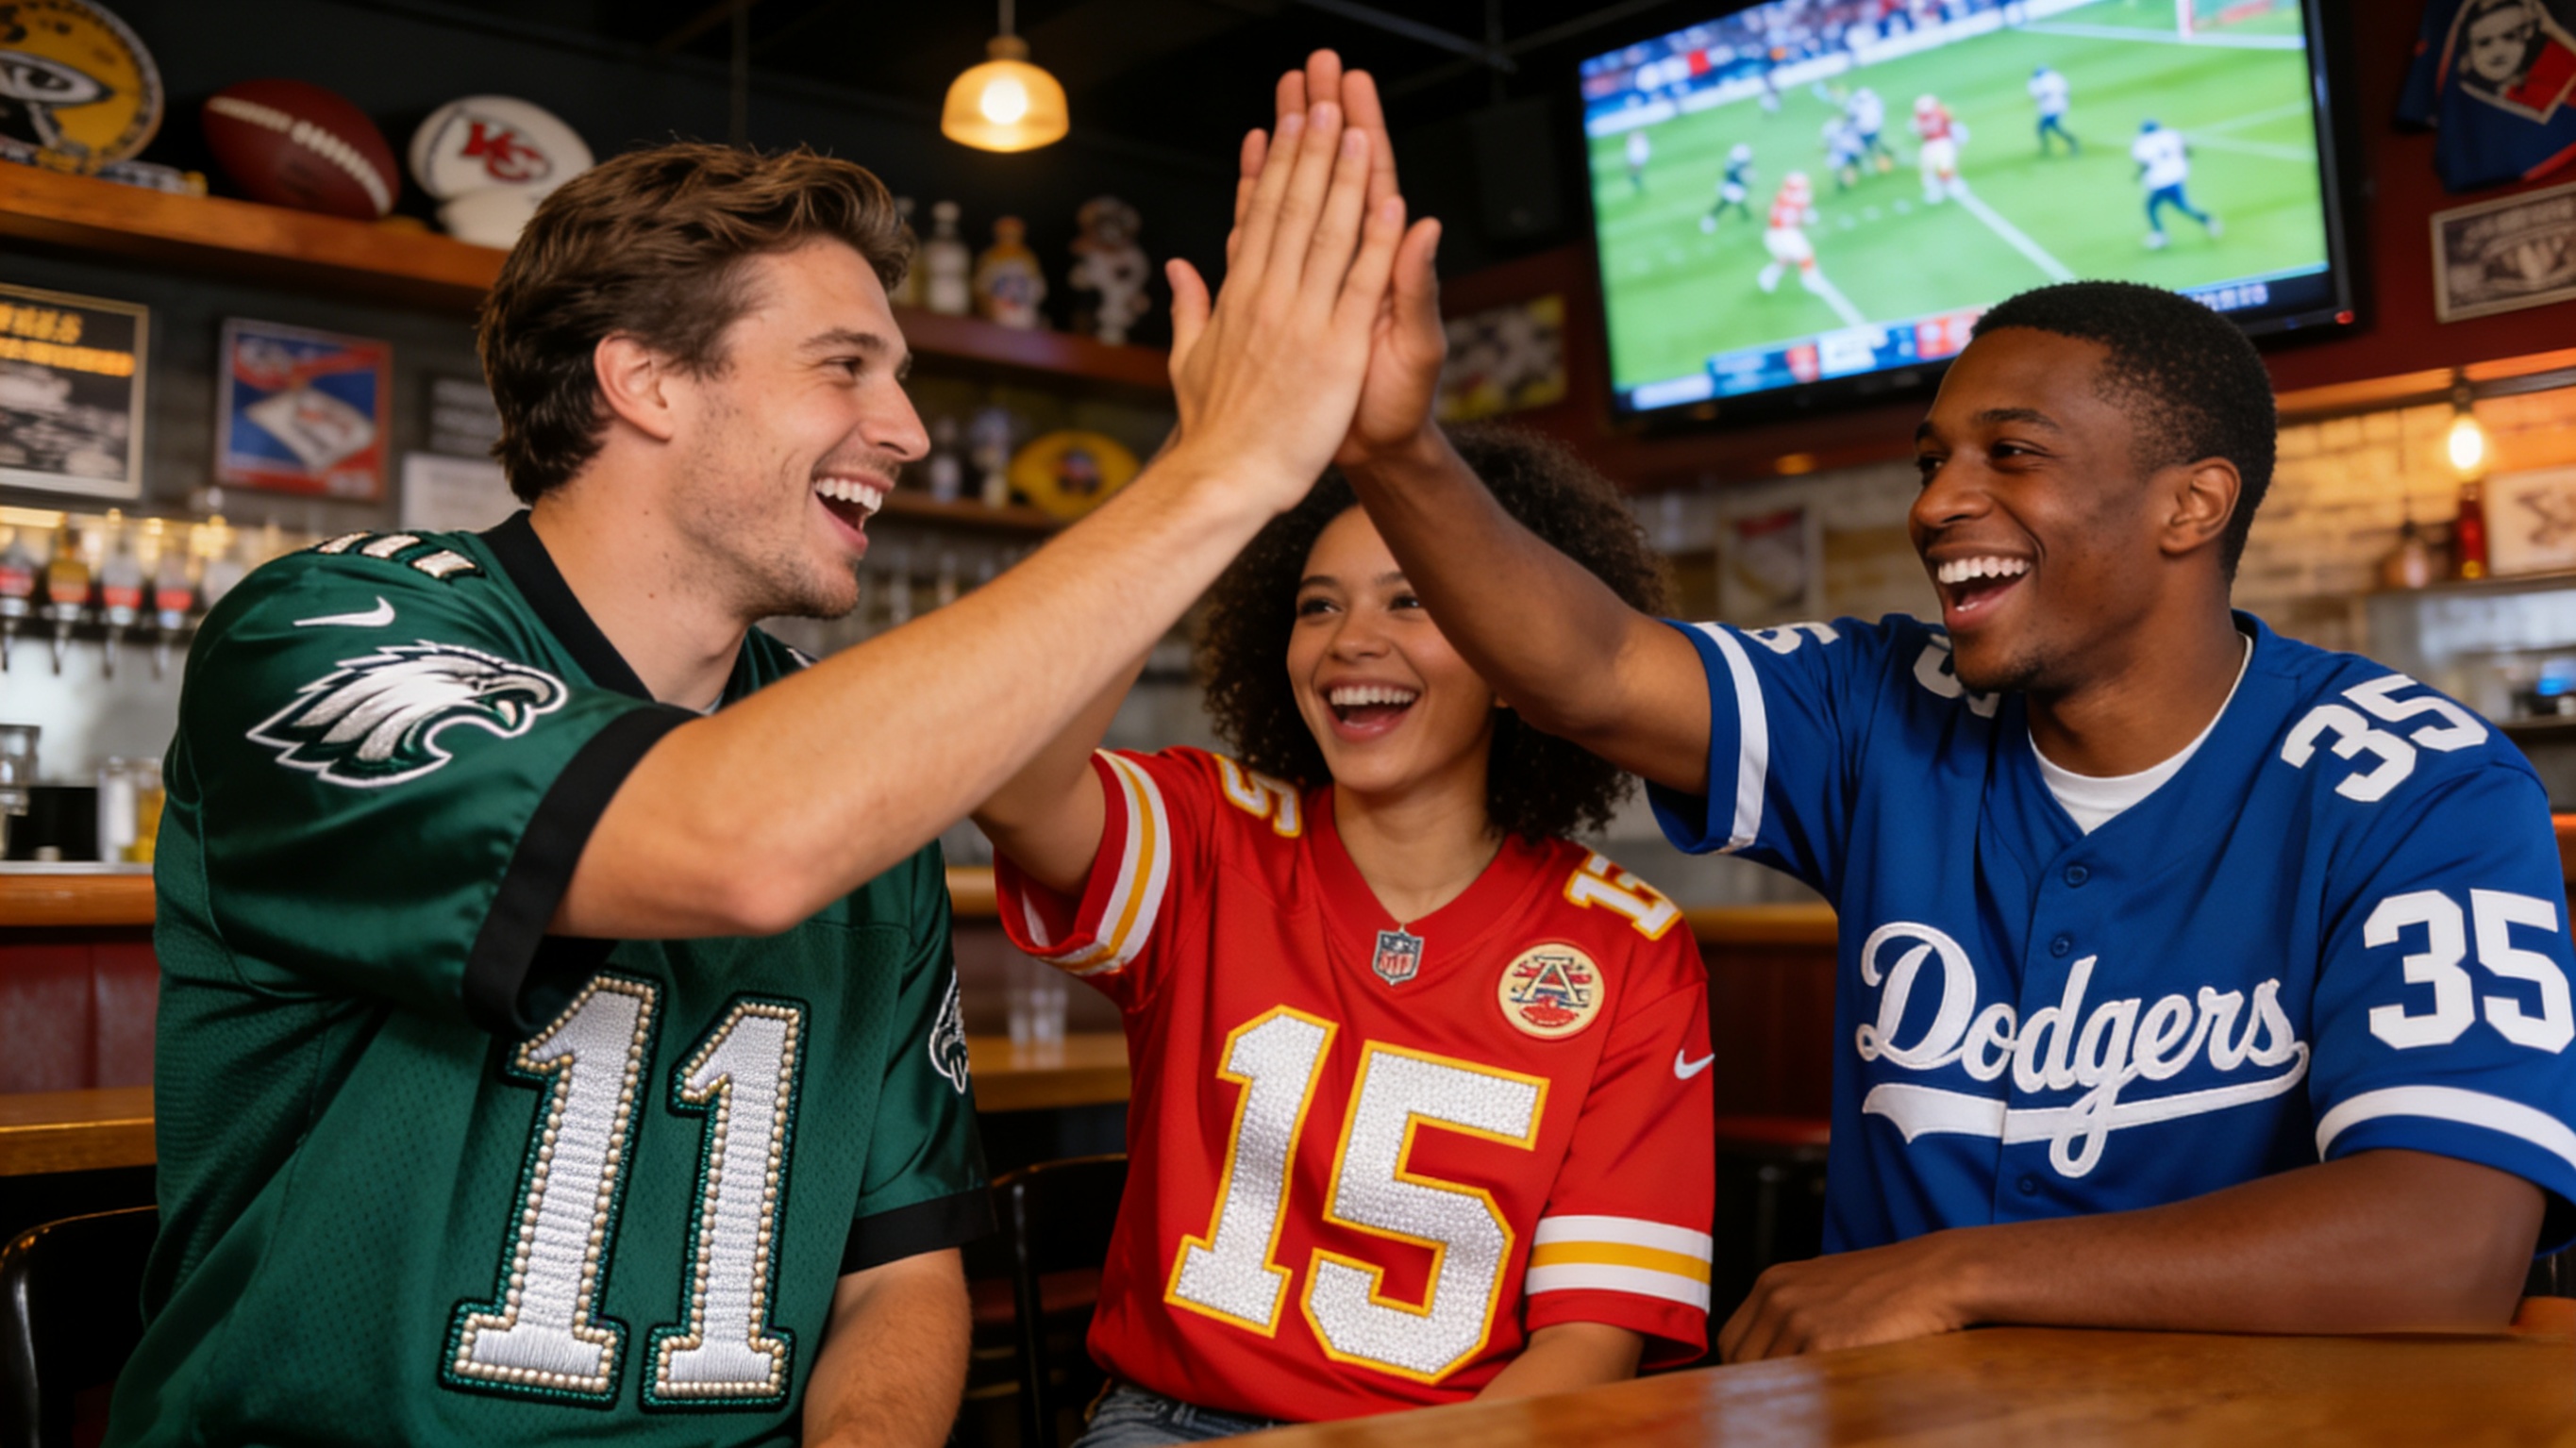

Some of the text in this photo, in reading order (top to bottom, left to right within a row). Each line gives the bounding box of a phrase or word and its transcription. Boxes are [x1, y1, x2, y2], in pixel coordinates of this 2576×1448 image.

[2280, 673, 2489, 803] 35
[1856, 921, 2302, 1178] Dodgers
[2363, 888, 2576, 1055] 35
[440, 967, 810, 1414] 11
[1163, 1003, 1551, 1386] 15
